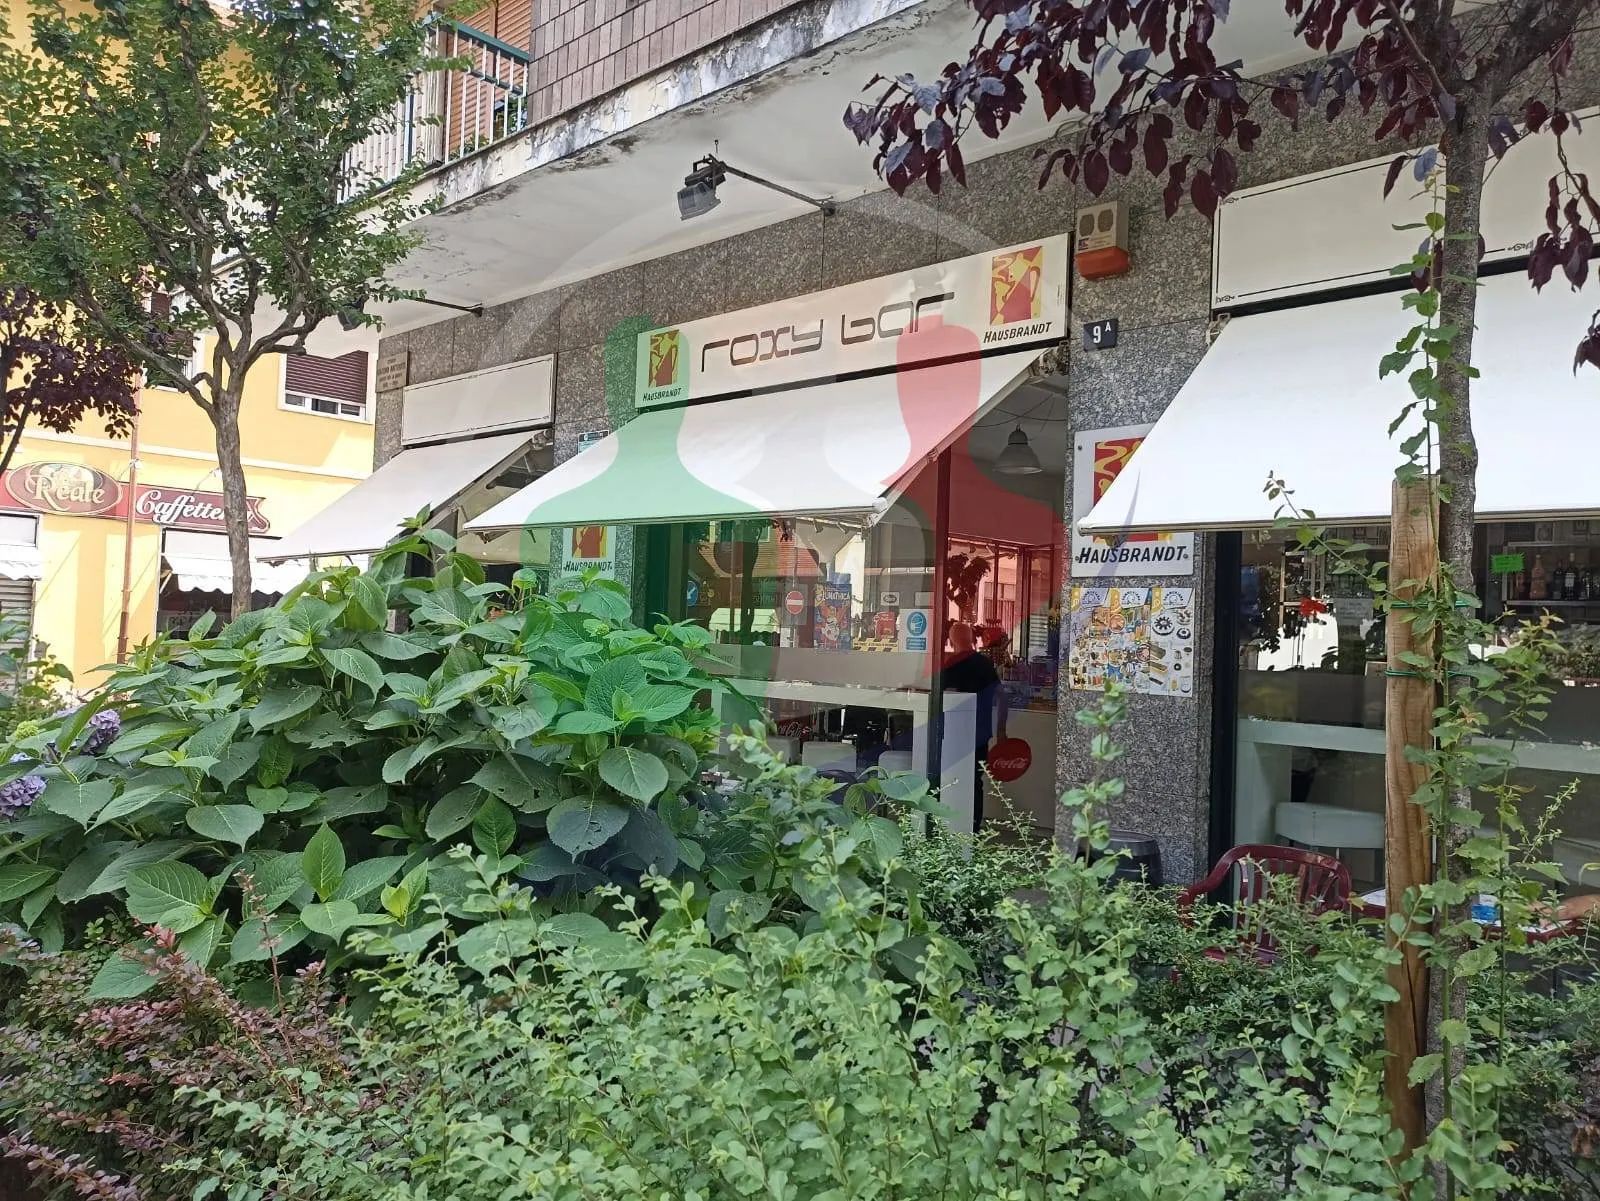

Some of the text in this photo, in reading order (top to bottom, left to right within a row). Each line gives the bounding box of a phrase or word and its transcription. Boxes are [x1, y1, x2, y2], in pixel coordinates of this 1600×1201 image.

[701, 291, 956, 373] roxy bar
[982, 321, 1053, 344] HAUSBRANDT
[642, 387, 682, 402] HAUSBRANDT
[24, 474, 106, 511] Reale
[136, 489, 254, 524] Caffette
[1078, 546, 1188, 564] HAUSBRANDT
